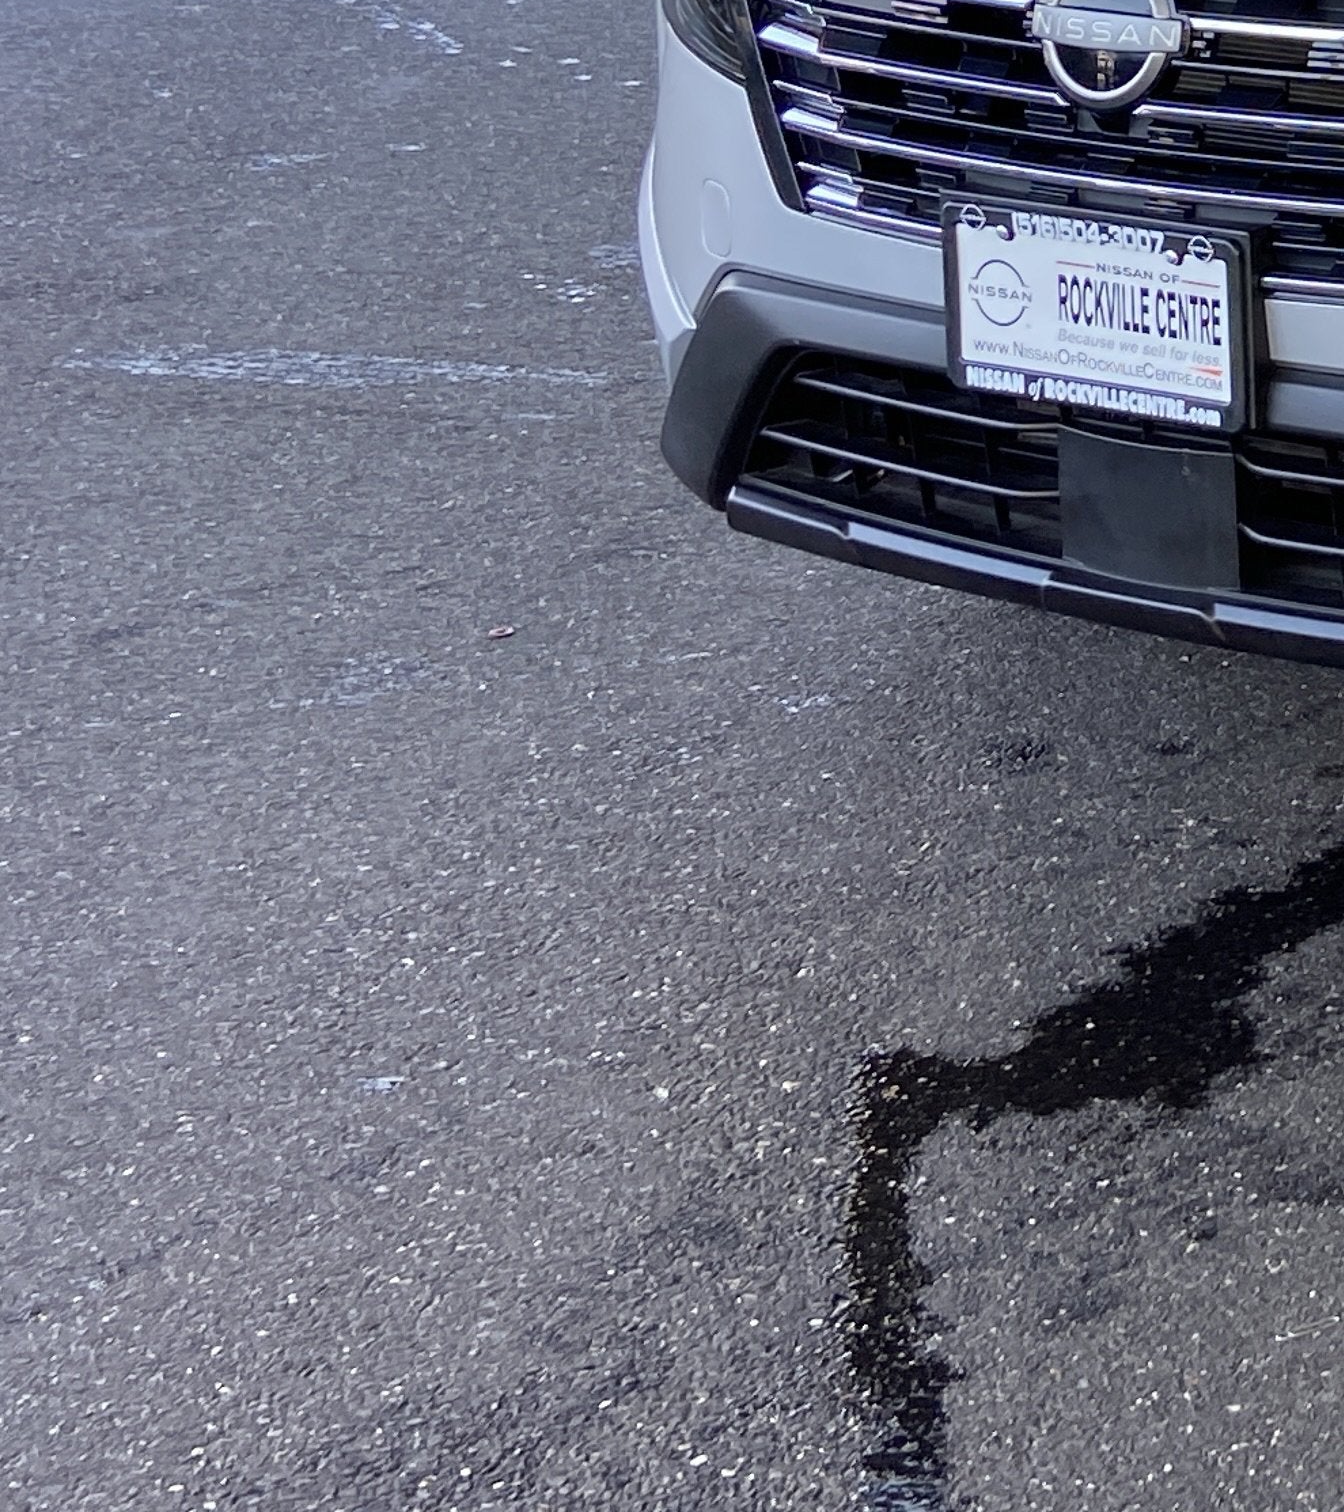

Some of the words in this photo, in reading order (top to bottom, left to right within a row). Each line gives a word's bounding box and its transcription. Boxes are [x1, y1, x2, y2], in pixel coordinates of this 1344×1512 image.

[1034, 11, 1179, 48] NISSAN
[1096, 262, 1153, 281] NISSAN
[1159, 272, 1181, 284] OF
[968, 283, 1033, 303] NISSAN
[1057, 273, 1150, 335] ROCKVILLE
[1155, 288, 1222, 347] CENTRE
[1058, 328, 1115, 350] Because
[1119, 342, 1139, 354] we
[1142, 344, 1166, 358] sell
[1170, 346, 1189, 362] for
